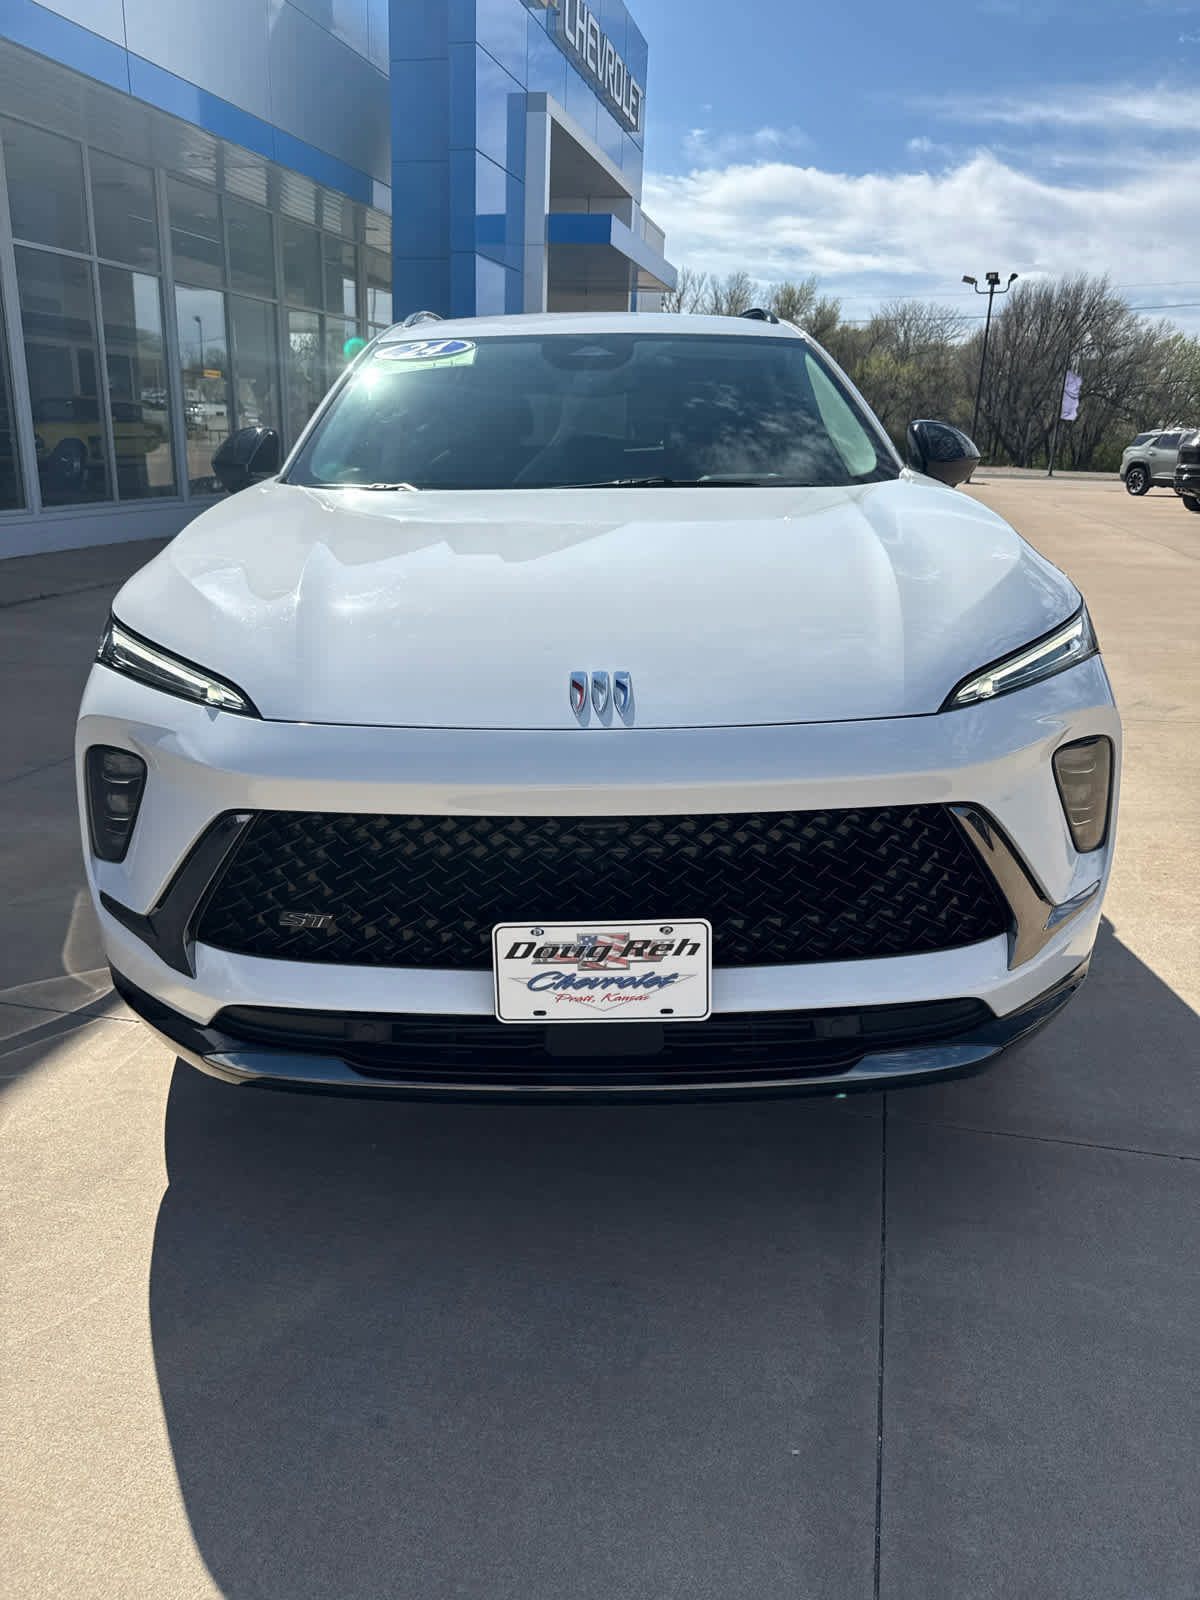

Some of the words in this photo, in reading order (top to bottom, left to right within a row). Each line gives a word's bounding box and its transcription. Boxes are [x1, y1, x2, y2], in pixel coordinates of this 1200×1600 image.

[564, 0, 643, 130] CHEVROLET
[279, 912, 334, 928] ST
[504, 941, 613, 963] Doug
[619, 938, 702, 958] Reh
[527, 971, 679, 991] Chevrolet
[601, 992, 649, 1003] Kansas
